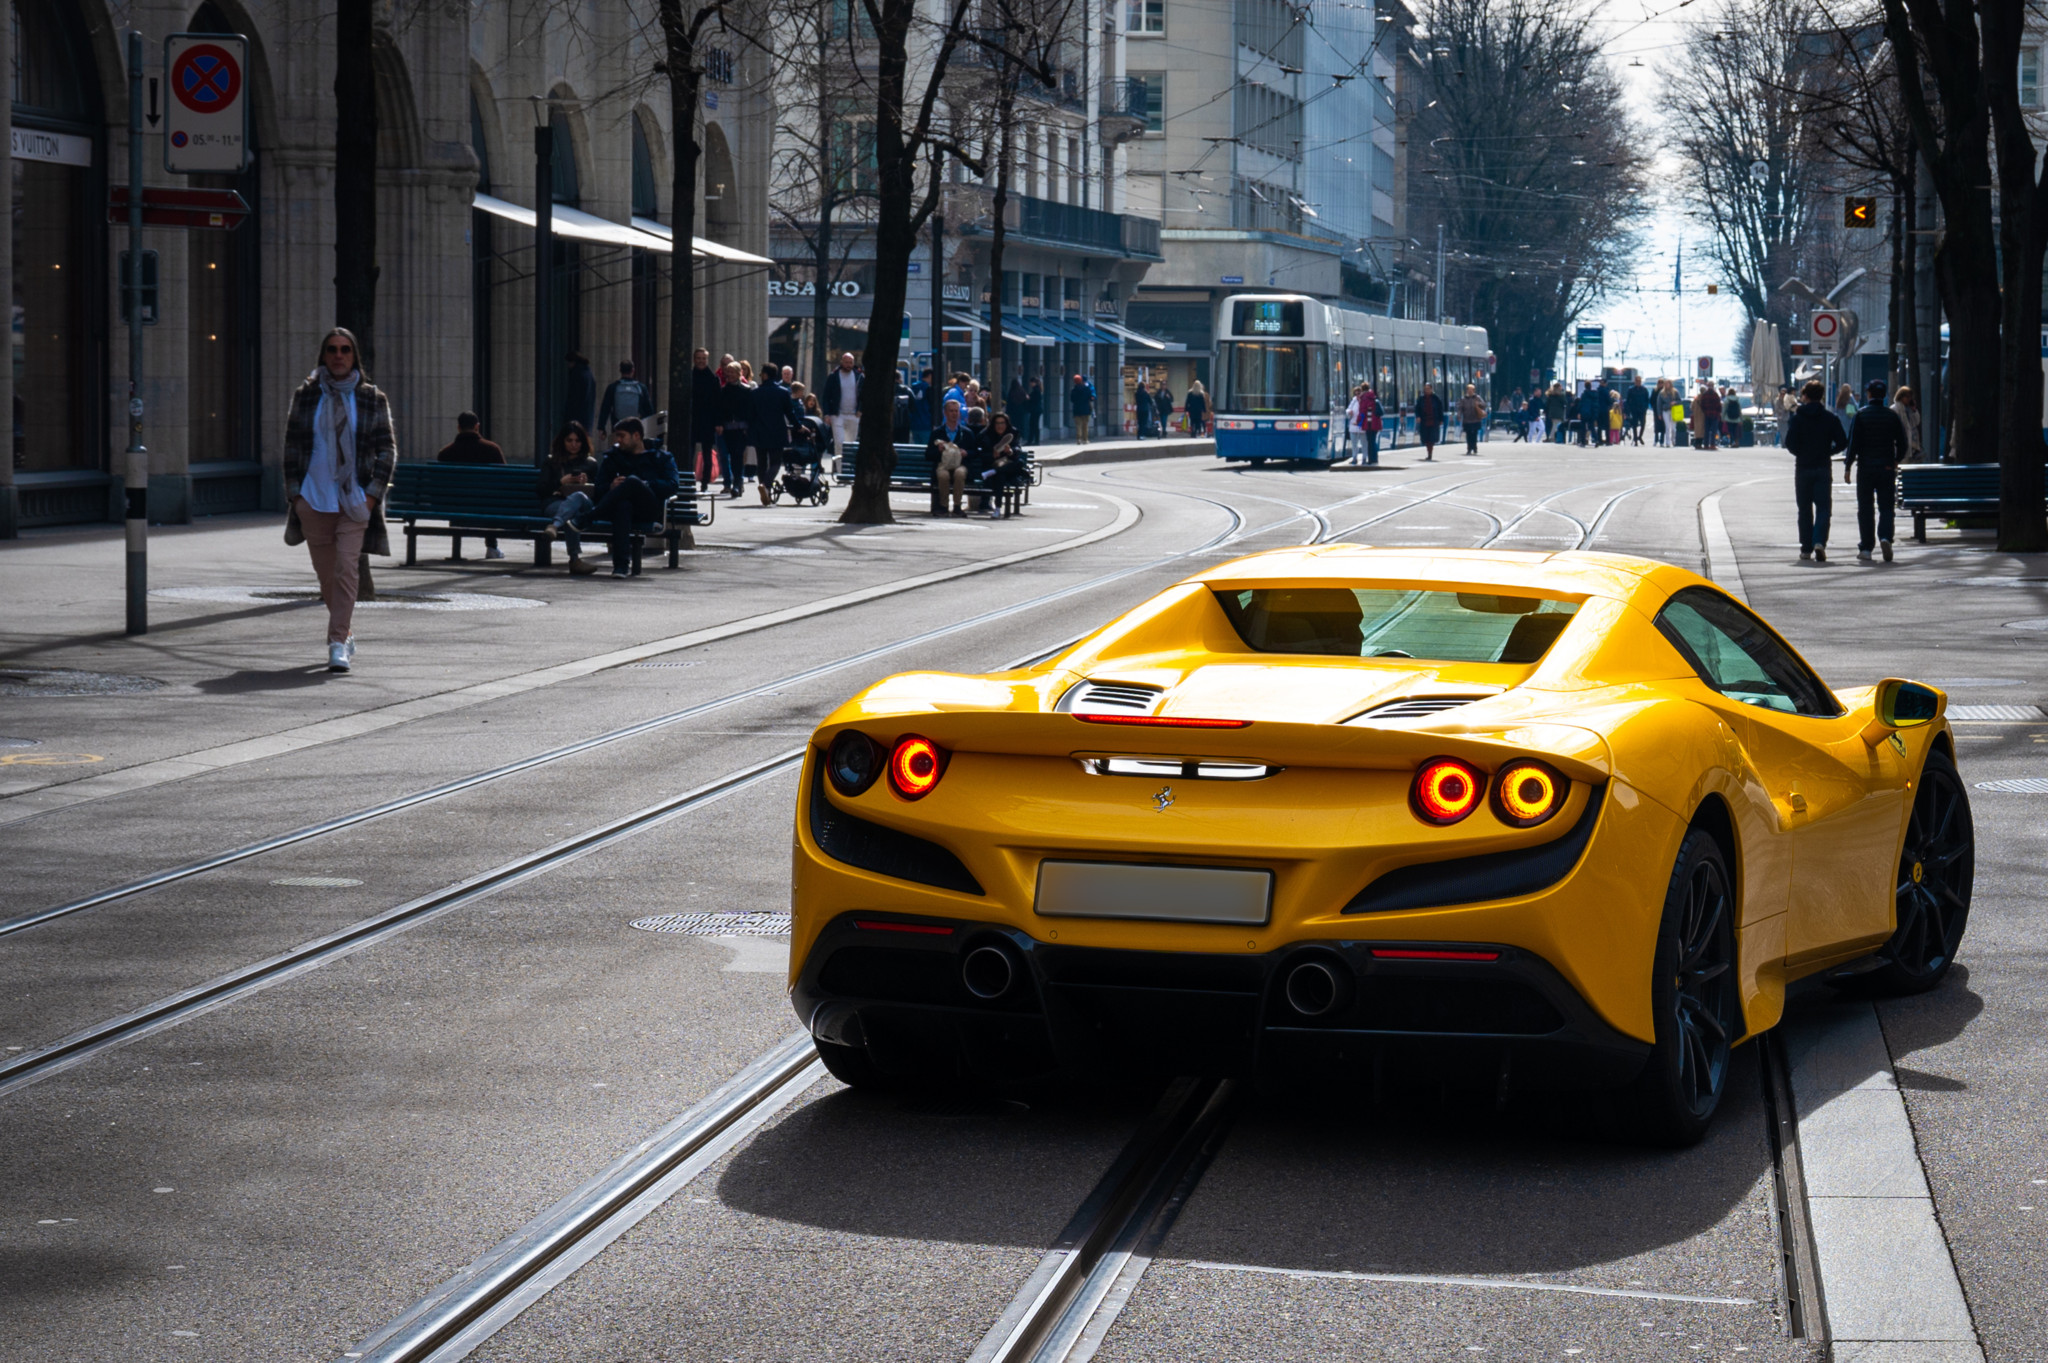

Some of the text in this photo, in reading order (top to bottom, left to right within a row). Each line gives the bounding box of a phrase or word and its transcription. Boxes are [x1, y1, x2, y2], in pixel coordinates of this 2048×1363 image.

[12, 132, 60, 157] S VUITTON
[1261, 303, 1276, 317] 11
